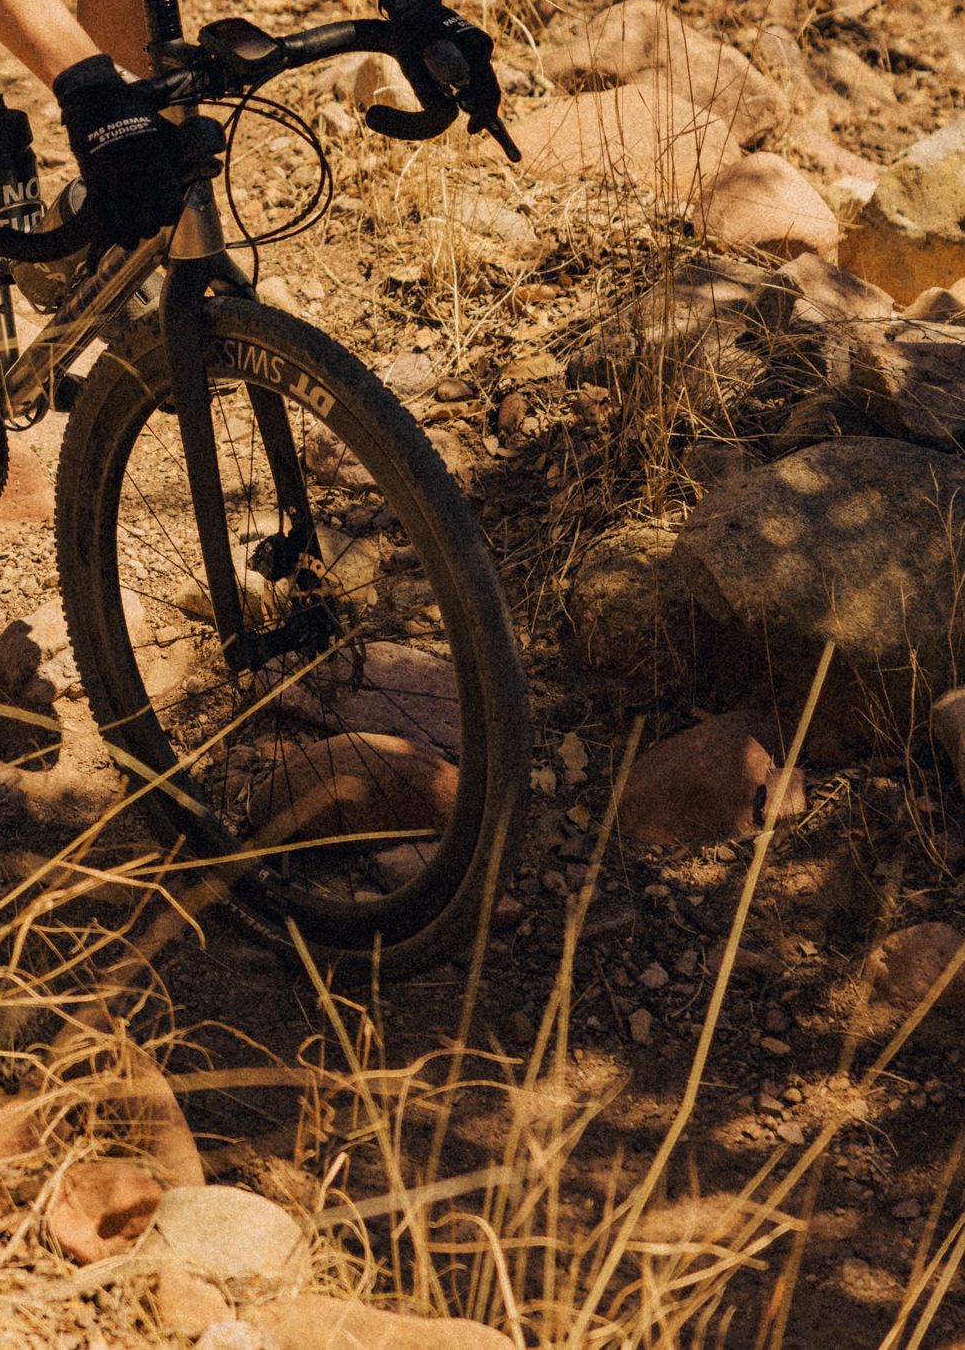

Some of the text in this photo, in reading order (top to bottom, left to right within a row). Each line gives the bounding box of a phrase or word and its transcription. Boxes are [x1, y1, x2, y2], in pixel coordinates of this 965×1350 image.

[87, 126, 106, 142] PAS
[107, 116, 152, 131] NORMAL
[210, 339, 337, 419] DT SWISS
